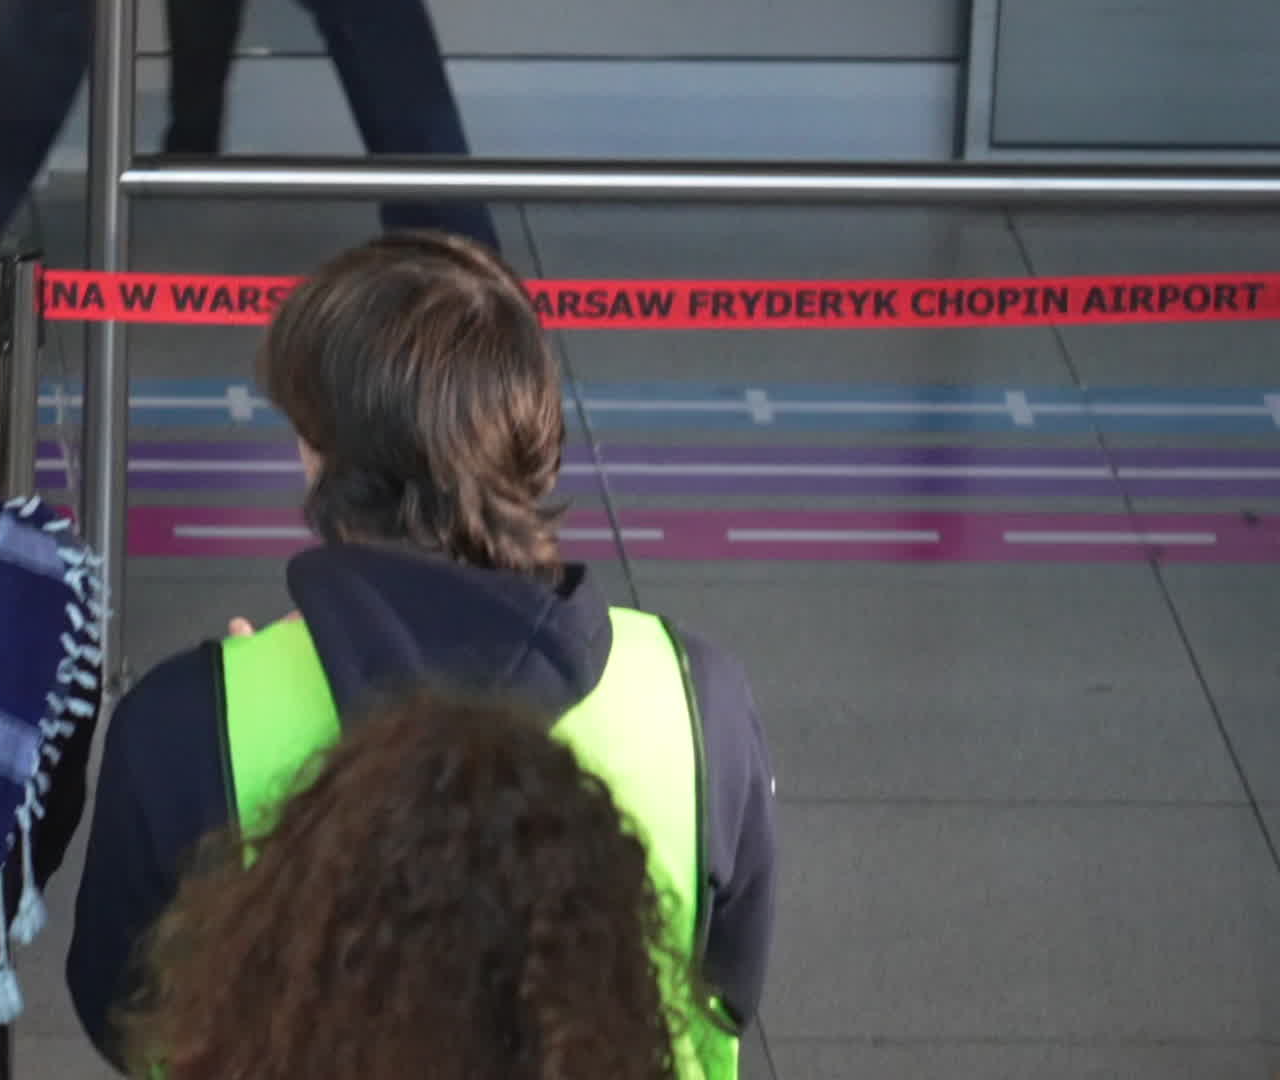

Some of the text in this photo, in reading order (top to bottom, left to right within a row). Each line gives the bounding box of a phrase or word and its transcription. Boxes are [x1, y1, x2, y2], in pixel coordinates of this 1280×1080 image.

[119, 284, 157, 311] W
[530, 282, 1264, 318] ARSAW FRYDERYK CHOPIN AIRPORT
